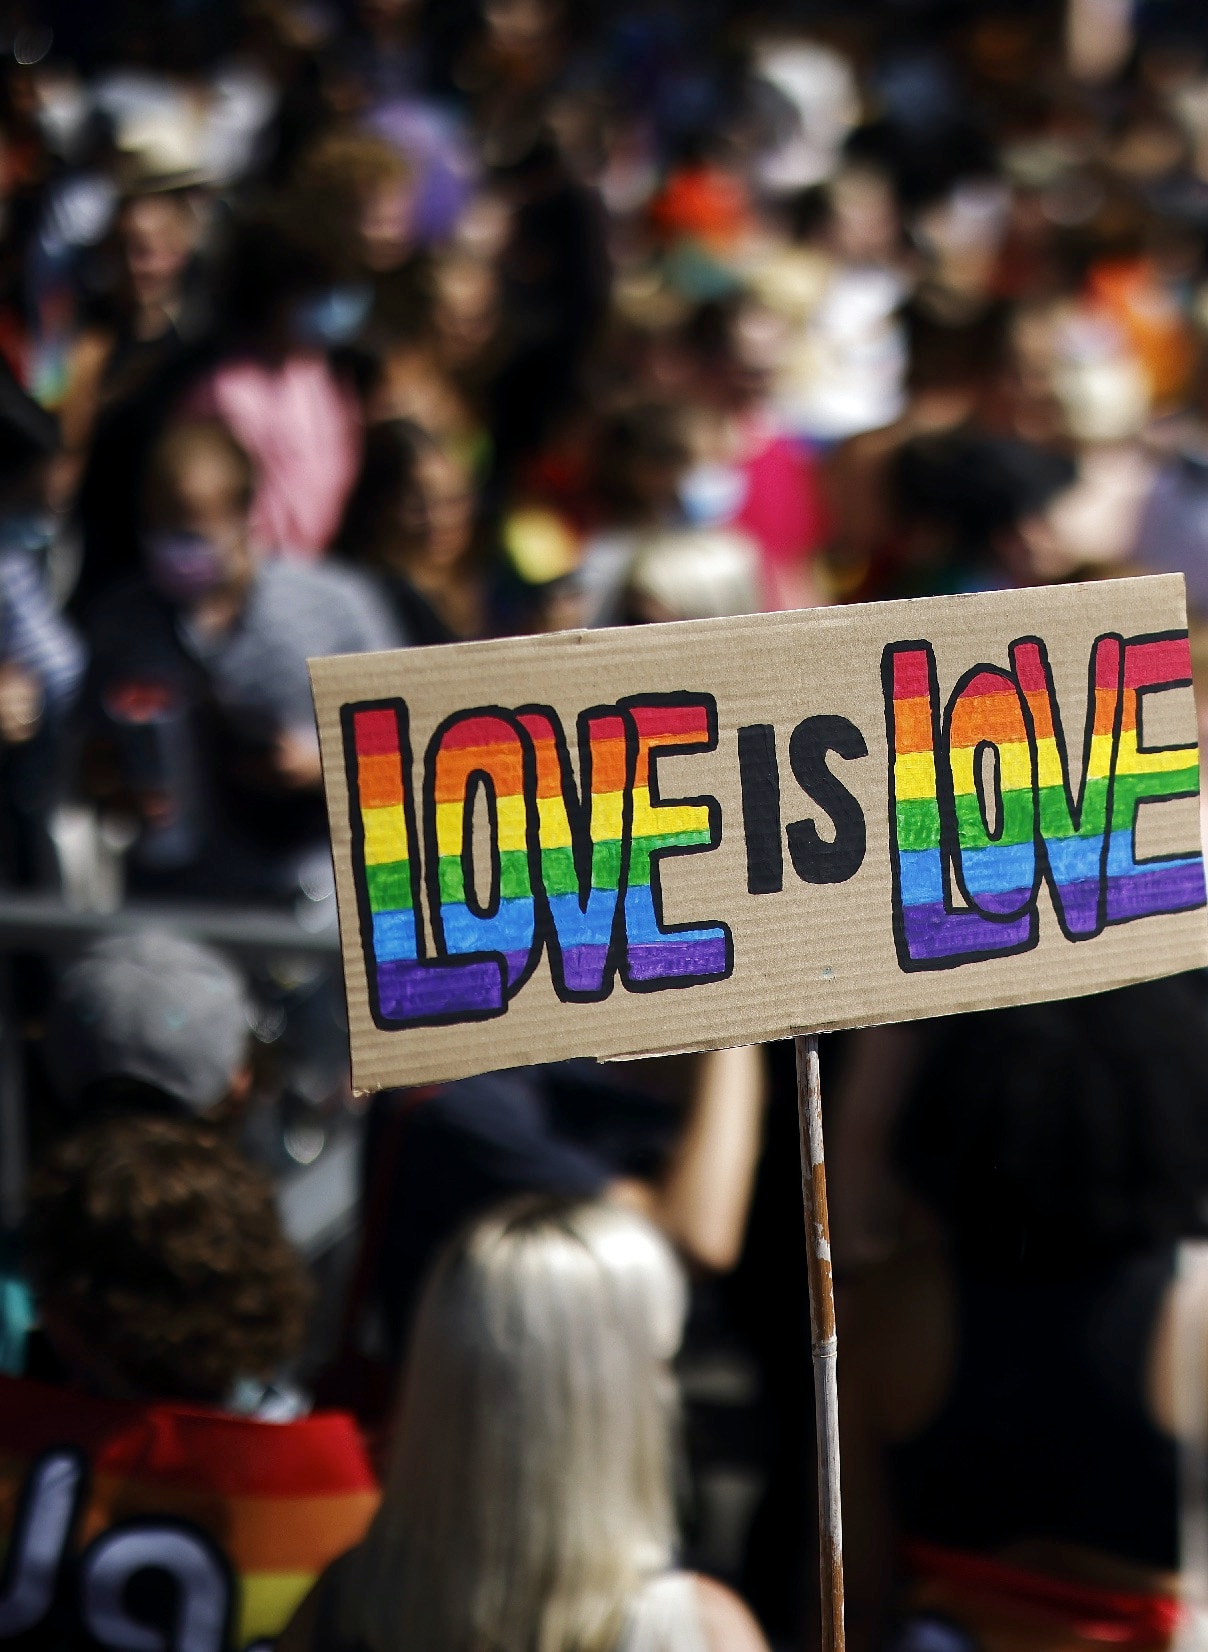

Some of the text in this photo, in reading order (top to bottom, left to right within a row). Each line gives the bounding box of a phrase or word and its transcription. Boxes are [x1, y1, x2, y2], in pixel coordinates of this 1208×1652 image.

[341, 631, 1208, 1029] LOVE IS LOVE
